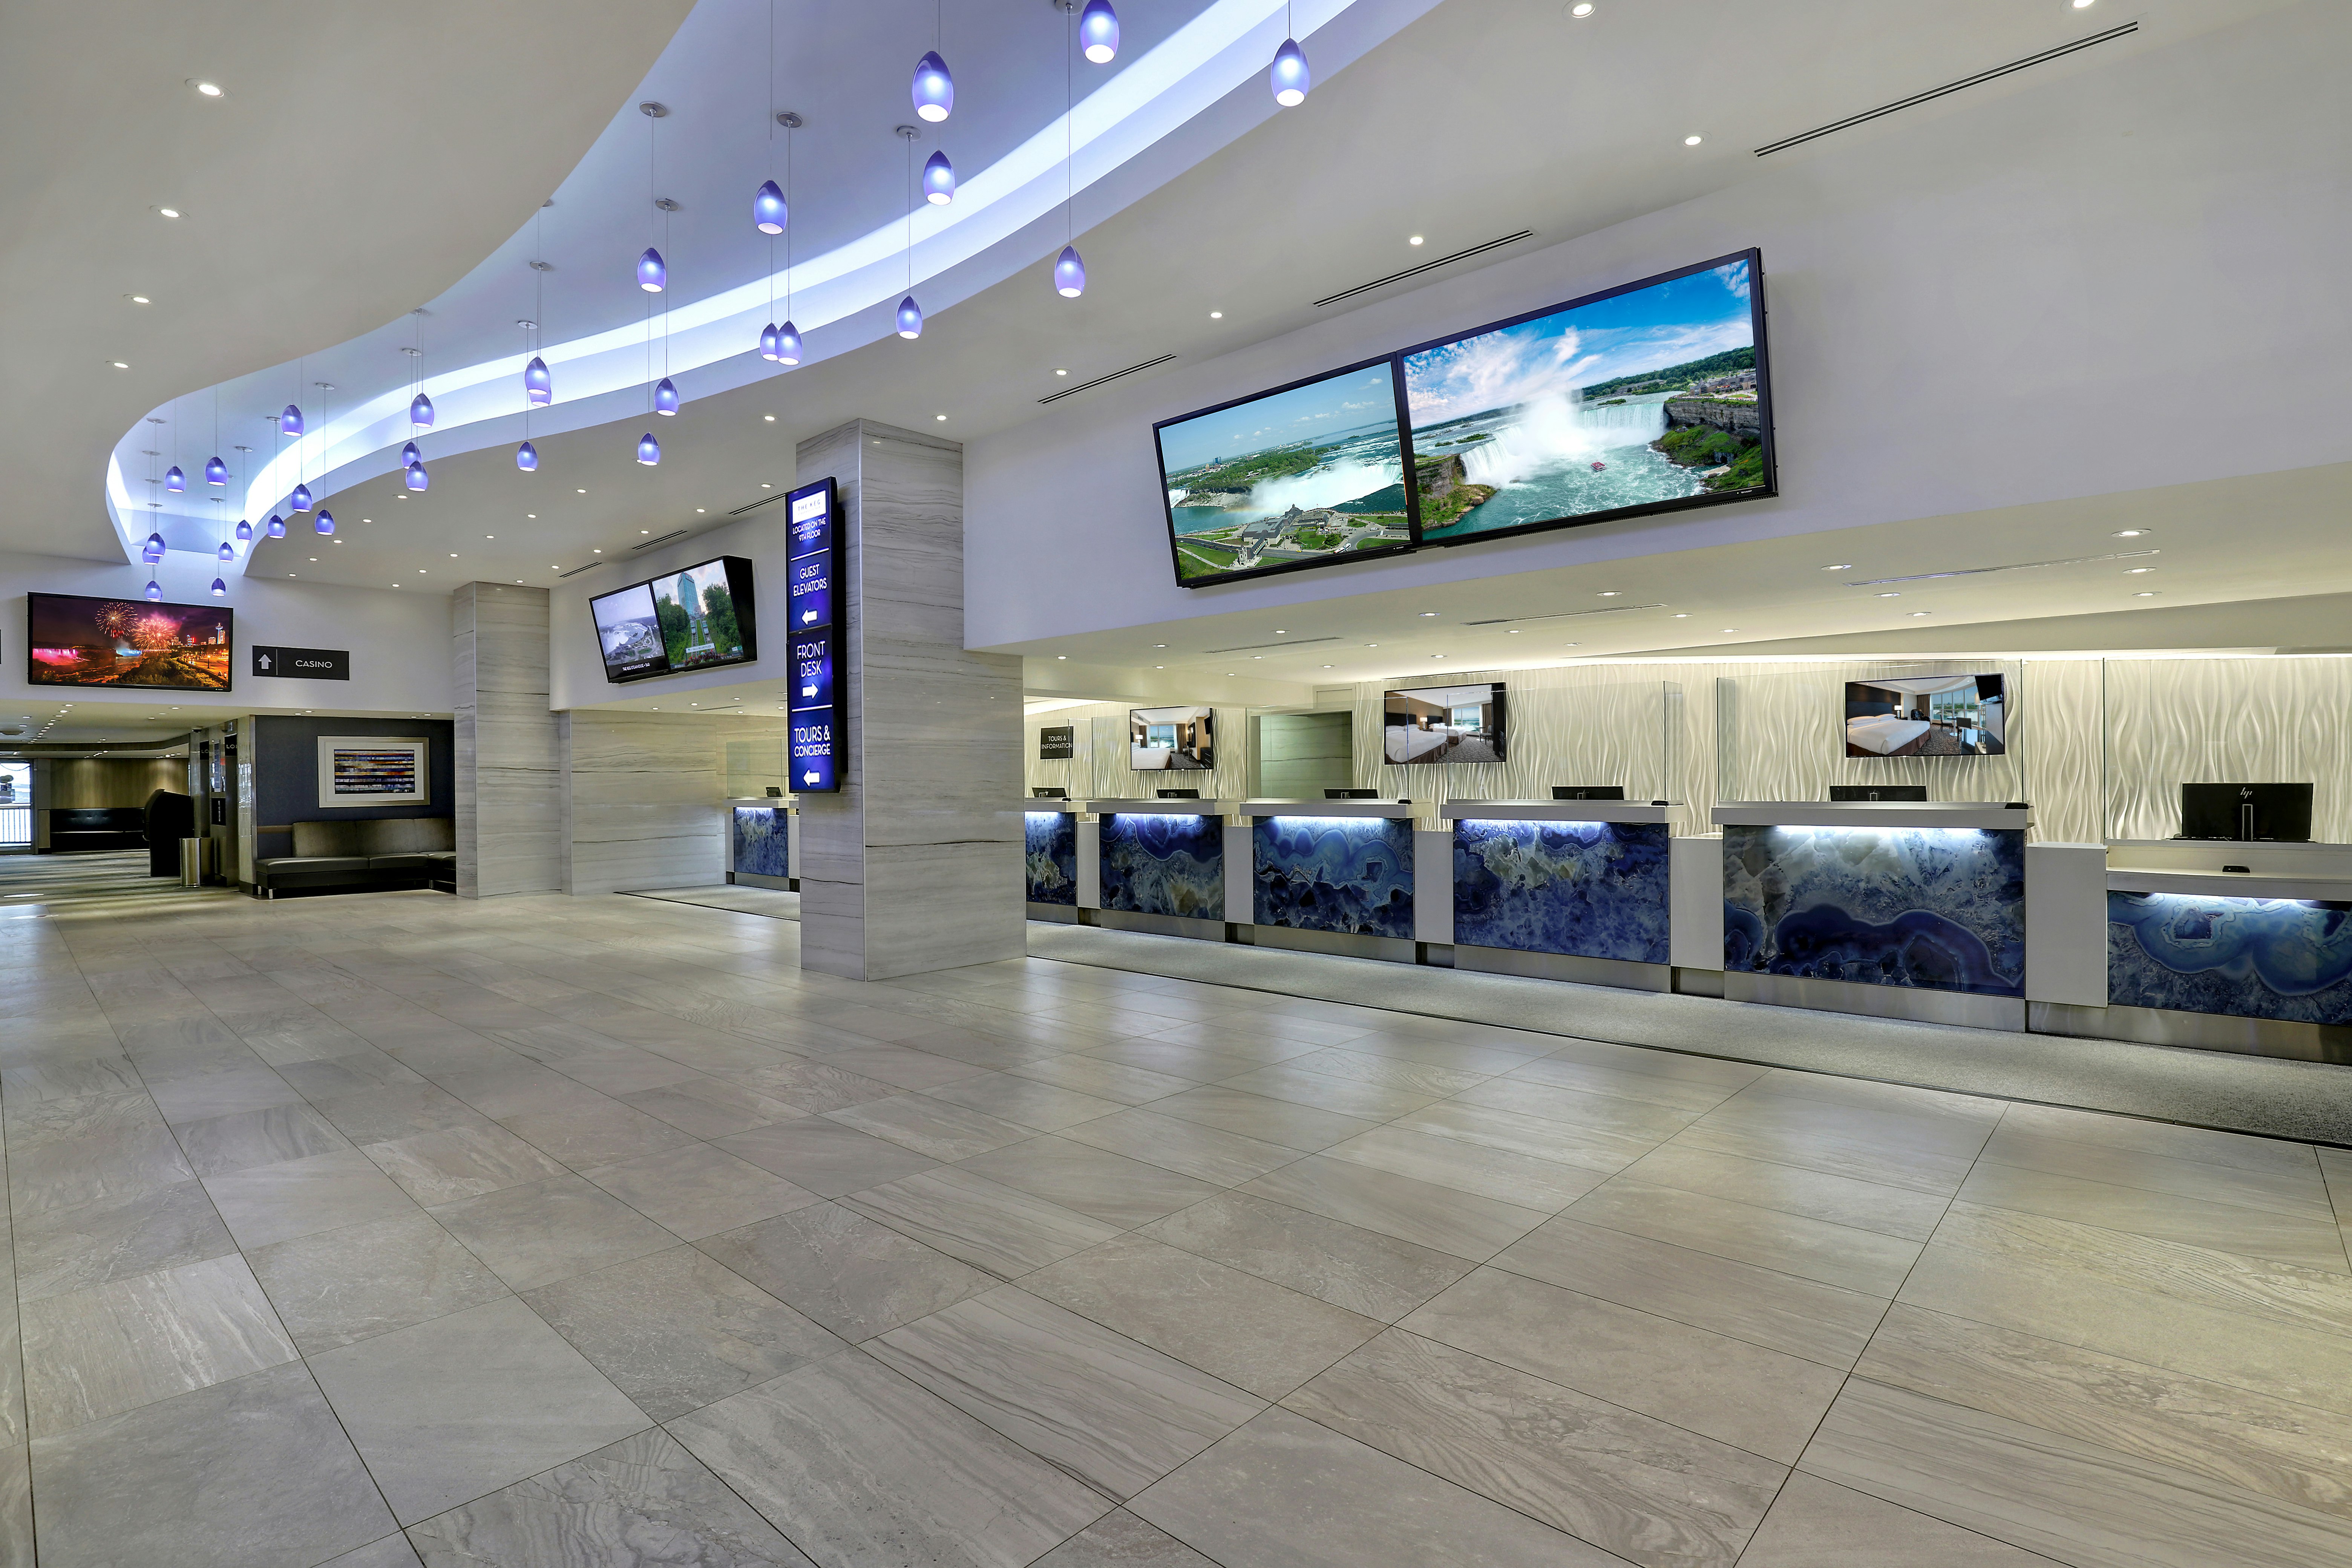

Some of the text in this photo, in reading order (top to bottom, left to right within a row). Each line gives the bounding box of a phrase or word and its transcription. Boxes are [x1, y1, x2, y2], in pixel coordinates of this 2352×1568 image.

[792, 517, 826, 535] LOCATED ON THE
[807, 529, 821, 540] FLOOR
[800, 564, 820, 579] GUEST
[793, 577, 827, 596] ELEVATORS
[797, 641, 825, 660] FRONT
[296, 660, 332, 668] CASINO
[801, 659, 822, 677] DESK
[794, 725, 830, 743] TOURS &
[794, 743, 830, 757] CONCIERGE
[2240, 787, 2253, 799] hp
